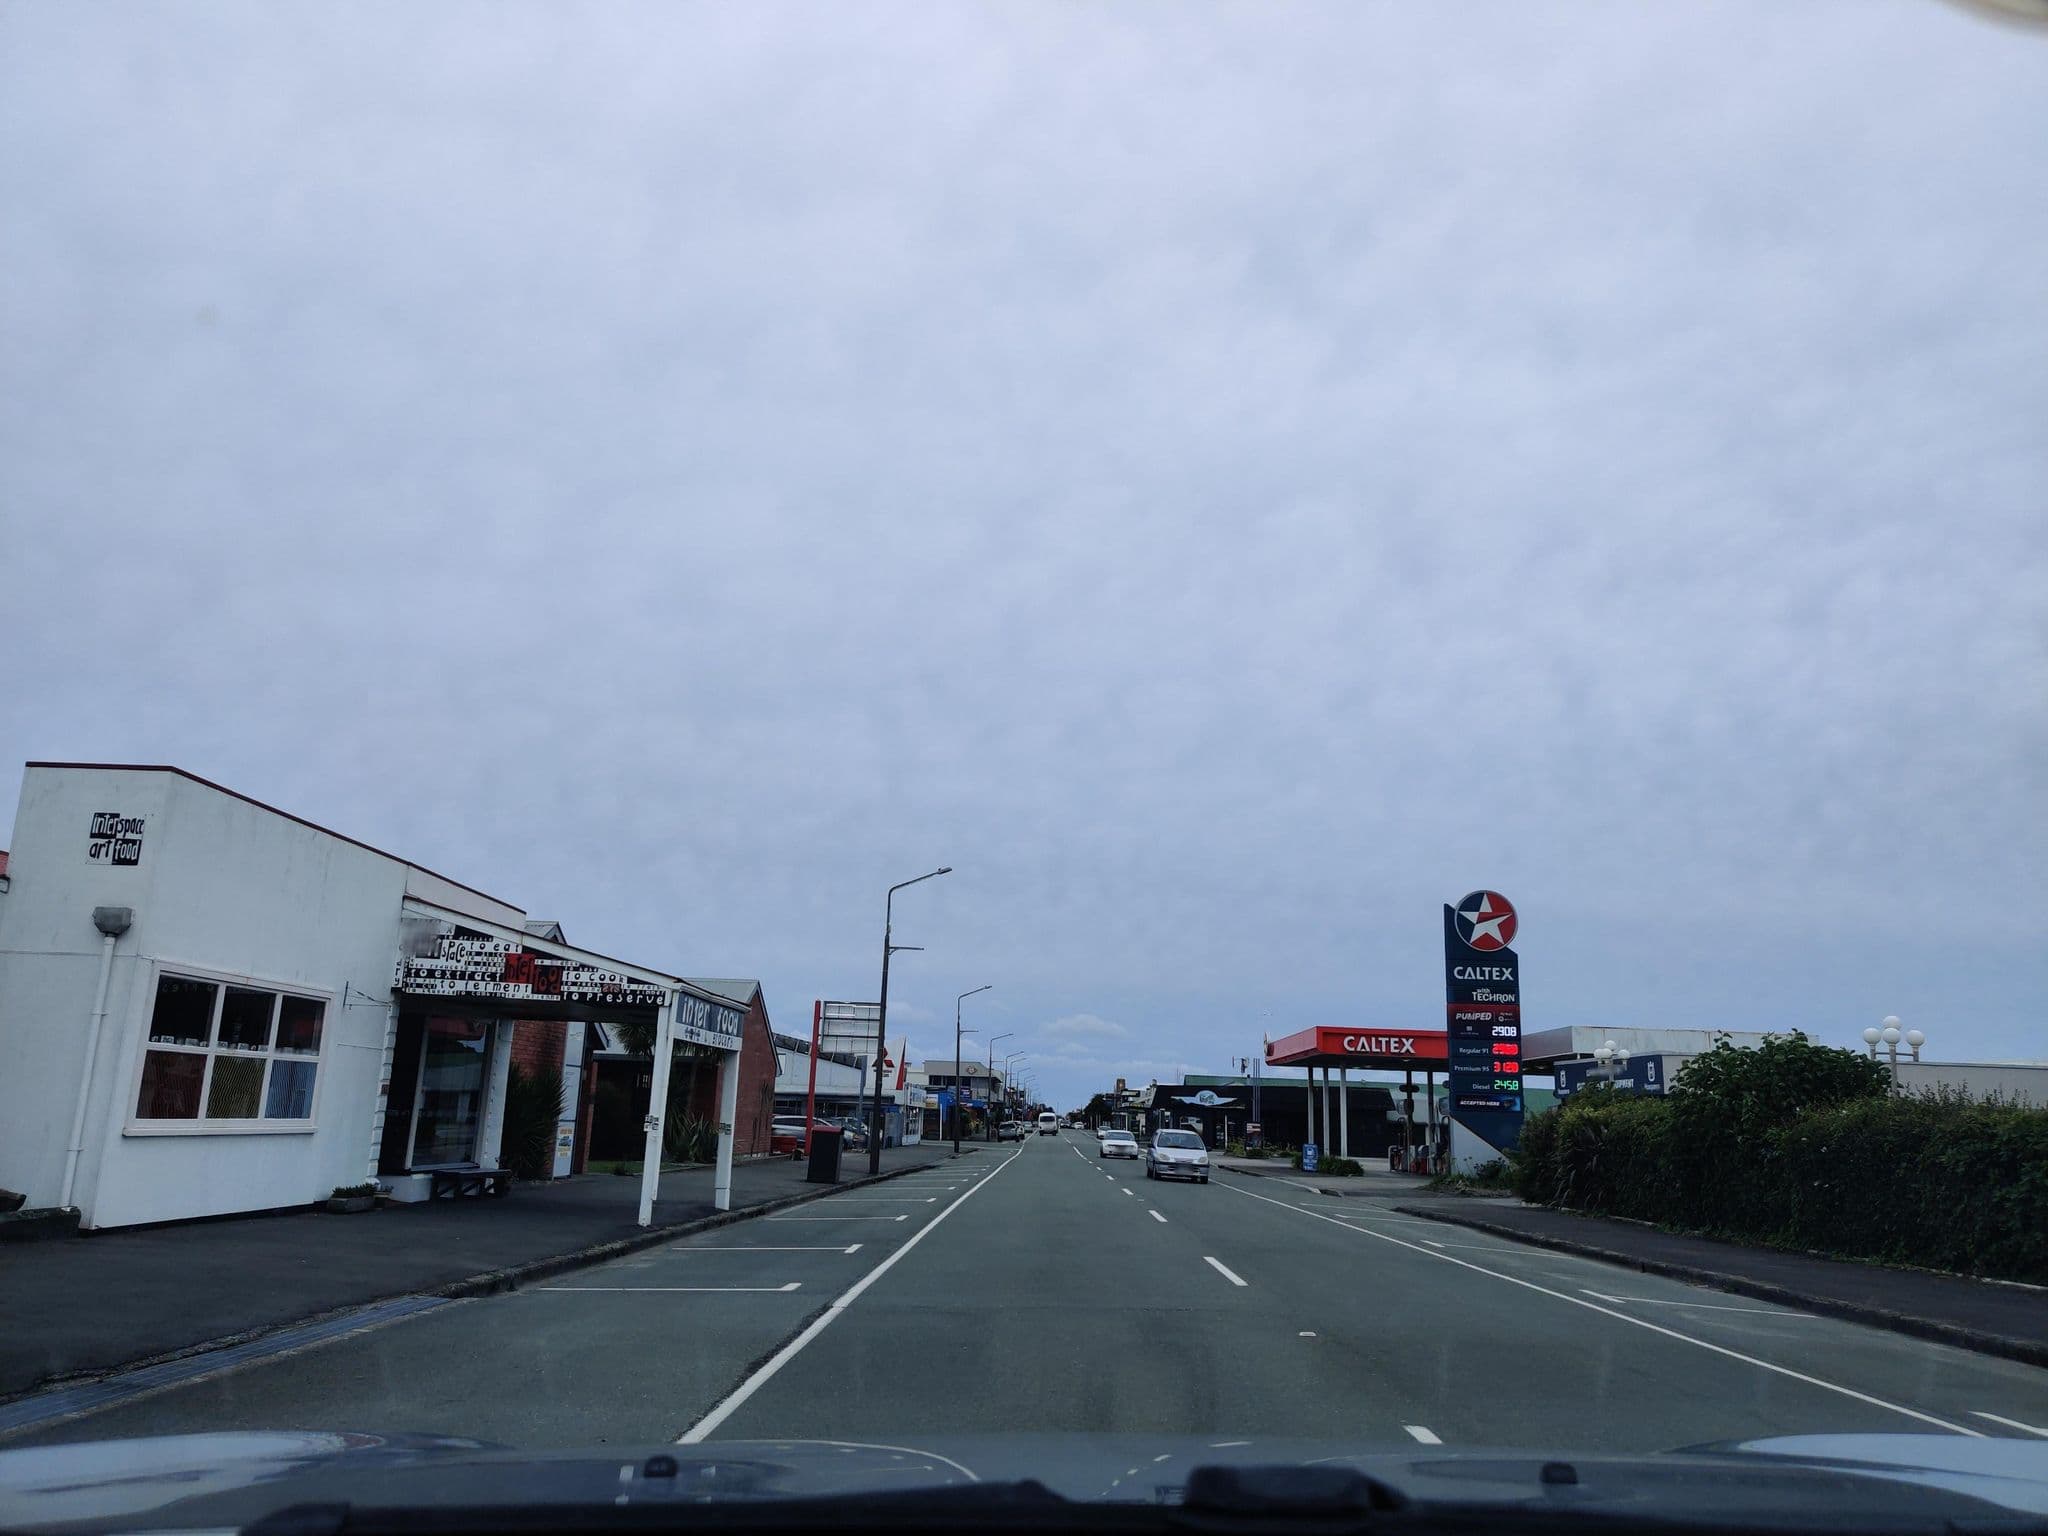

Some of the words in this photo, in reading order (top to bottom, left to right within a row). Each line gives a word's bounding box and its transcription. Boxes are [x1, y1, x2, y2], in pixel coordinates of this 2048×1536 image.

[89, 840, 113, 859] art
[115, 840, 140, 860] food
[470, 942, 486, 950] to
[494, 943, 520, 952] eat
[434, 970, 501, 982] extract
[566, 972, 581, 980] to
[589, 973, 624, 983] cook
[1454, 966, 1514, 981] CALTEX
[440, 980, 456, 988] to
[465, 980, 528, 993] ferment
[563, 992, 579, 1000] to
[586, 992, 664, 1005] preserve
[1472, 992, 1515, 1003] TECHRON
[682, 996, 710, 1028] inter
[717, 1007, 739, 1036] food
[1456, 1012, 1492, 1021] PUMPED
[1492, 1026, 1517, 1036] 2908
[1344, 1036, 1416, 1054] CALTEX
[1494, 1080, 1520, 1091] 2458
